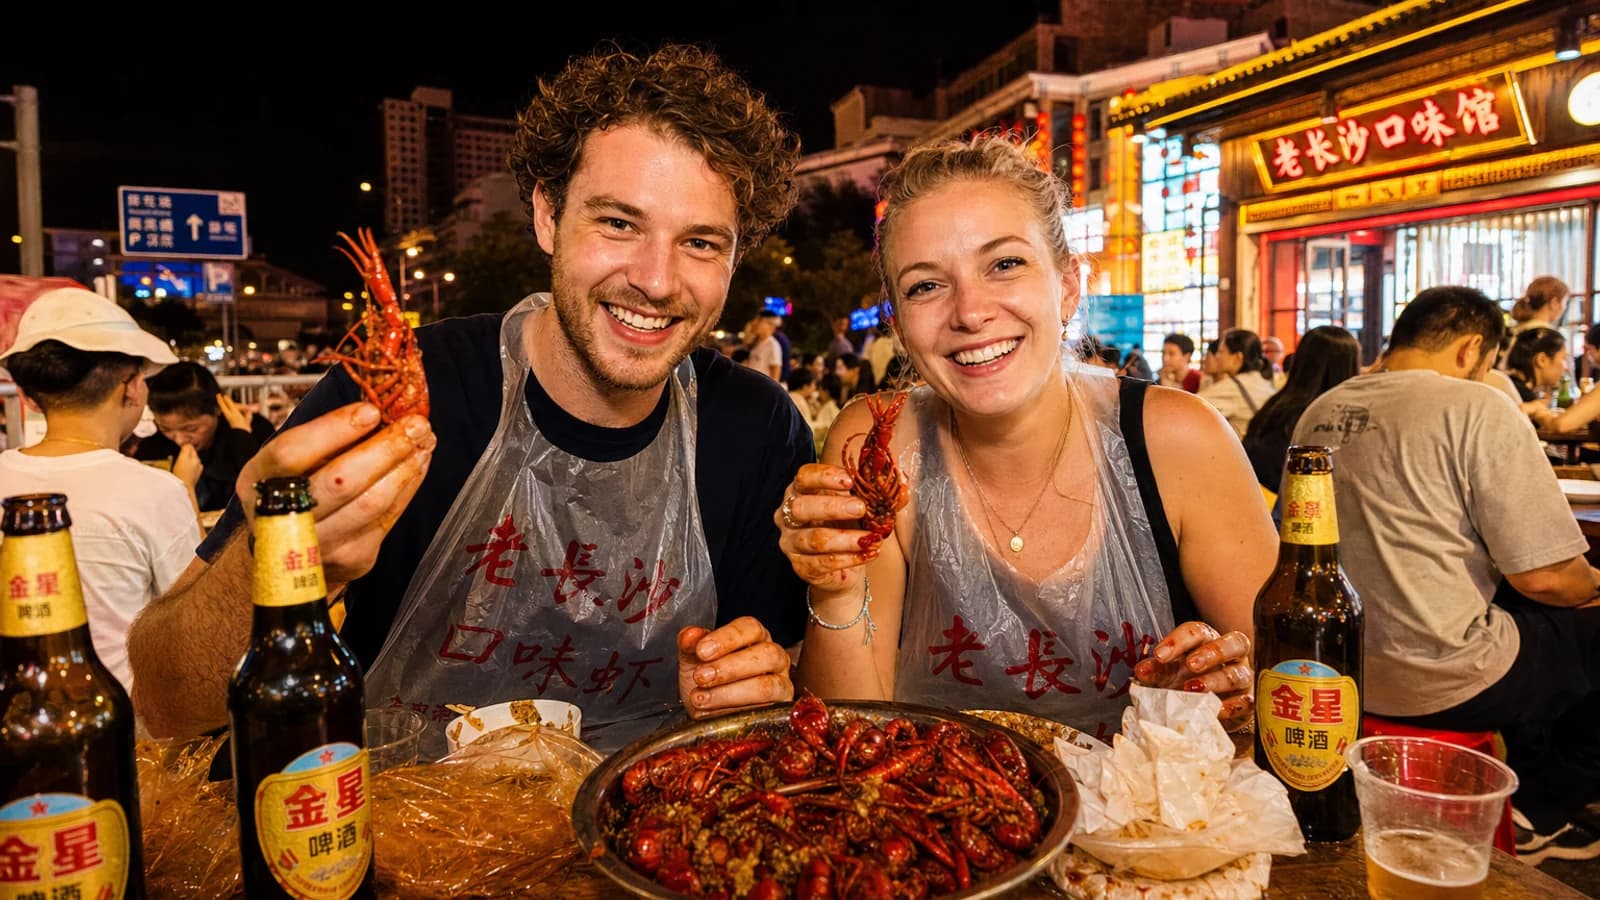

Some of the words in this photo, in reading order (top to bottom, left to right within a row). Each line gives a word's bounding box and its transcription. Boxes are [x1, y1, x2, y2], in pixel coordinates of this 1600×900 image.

[1273, 88, 1501, 179] 老长沙口味馆
[207, 263, 229, 292] P
[464, 513, 681, 624] 老長沙
[439, 624, 664, 704] 口味虾
[928, 614, 1155, 700] 老長沙
[1270, 684, 1344, 724] 金星
[1285, 727, 1329, 750] 啤酒
[284, 766, 367, 831] 金星
[0, 821, 104, 883] 金星
[308, 820, 357, 858] 啤酒
